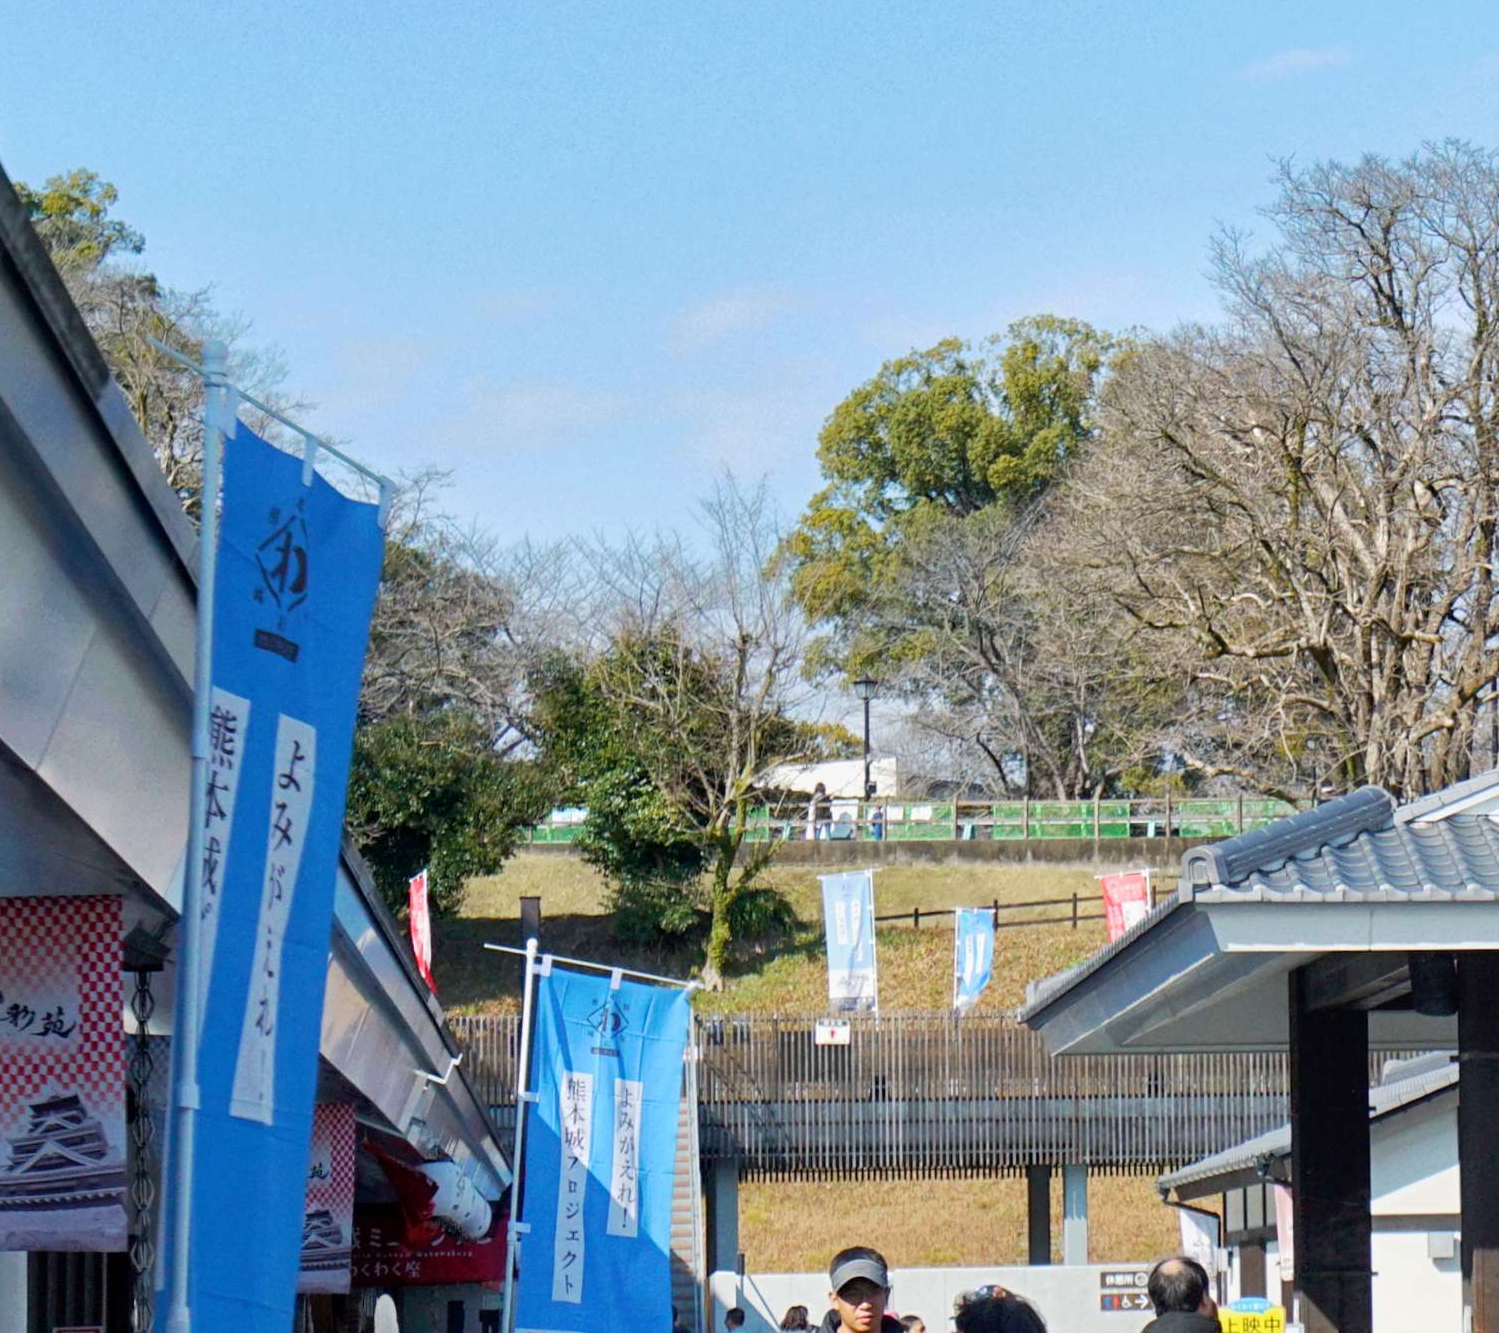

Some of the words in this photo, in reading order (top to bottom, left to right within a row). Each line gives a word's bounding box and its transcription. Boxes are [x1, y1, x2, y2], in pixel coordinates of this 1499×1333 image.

[562, 1078, 586, 1297] 熊本城プロジェクト
